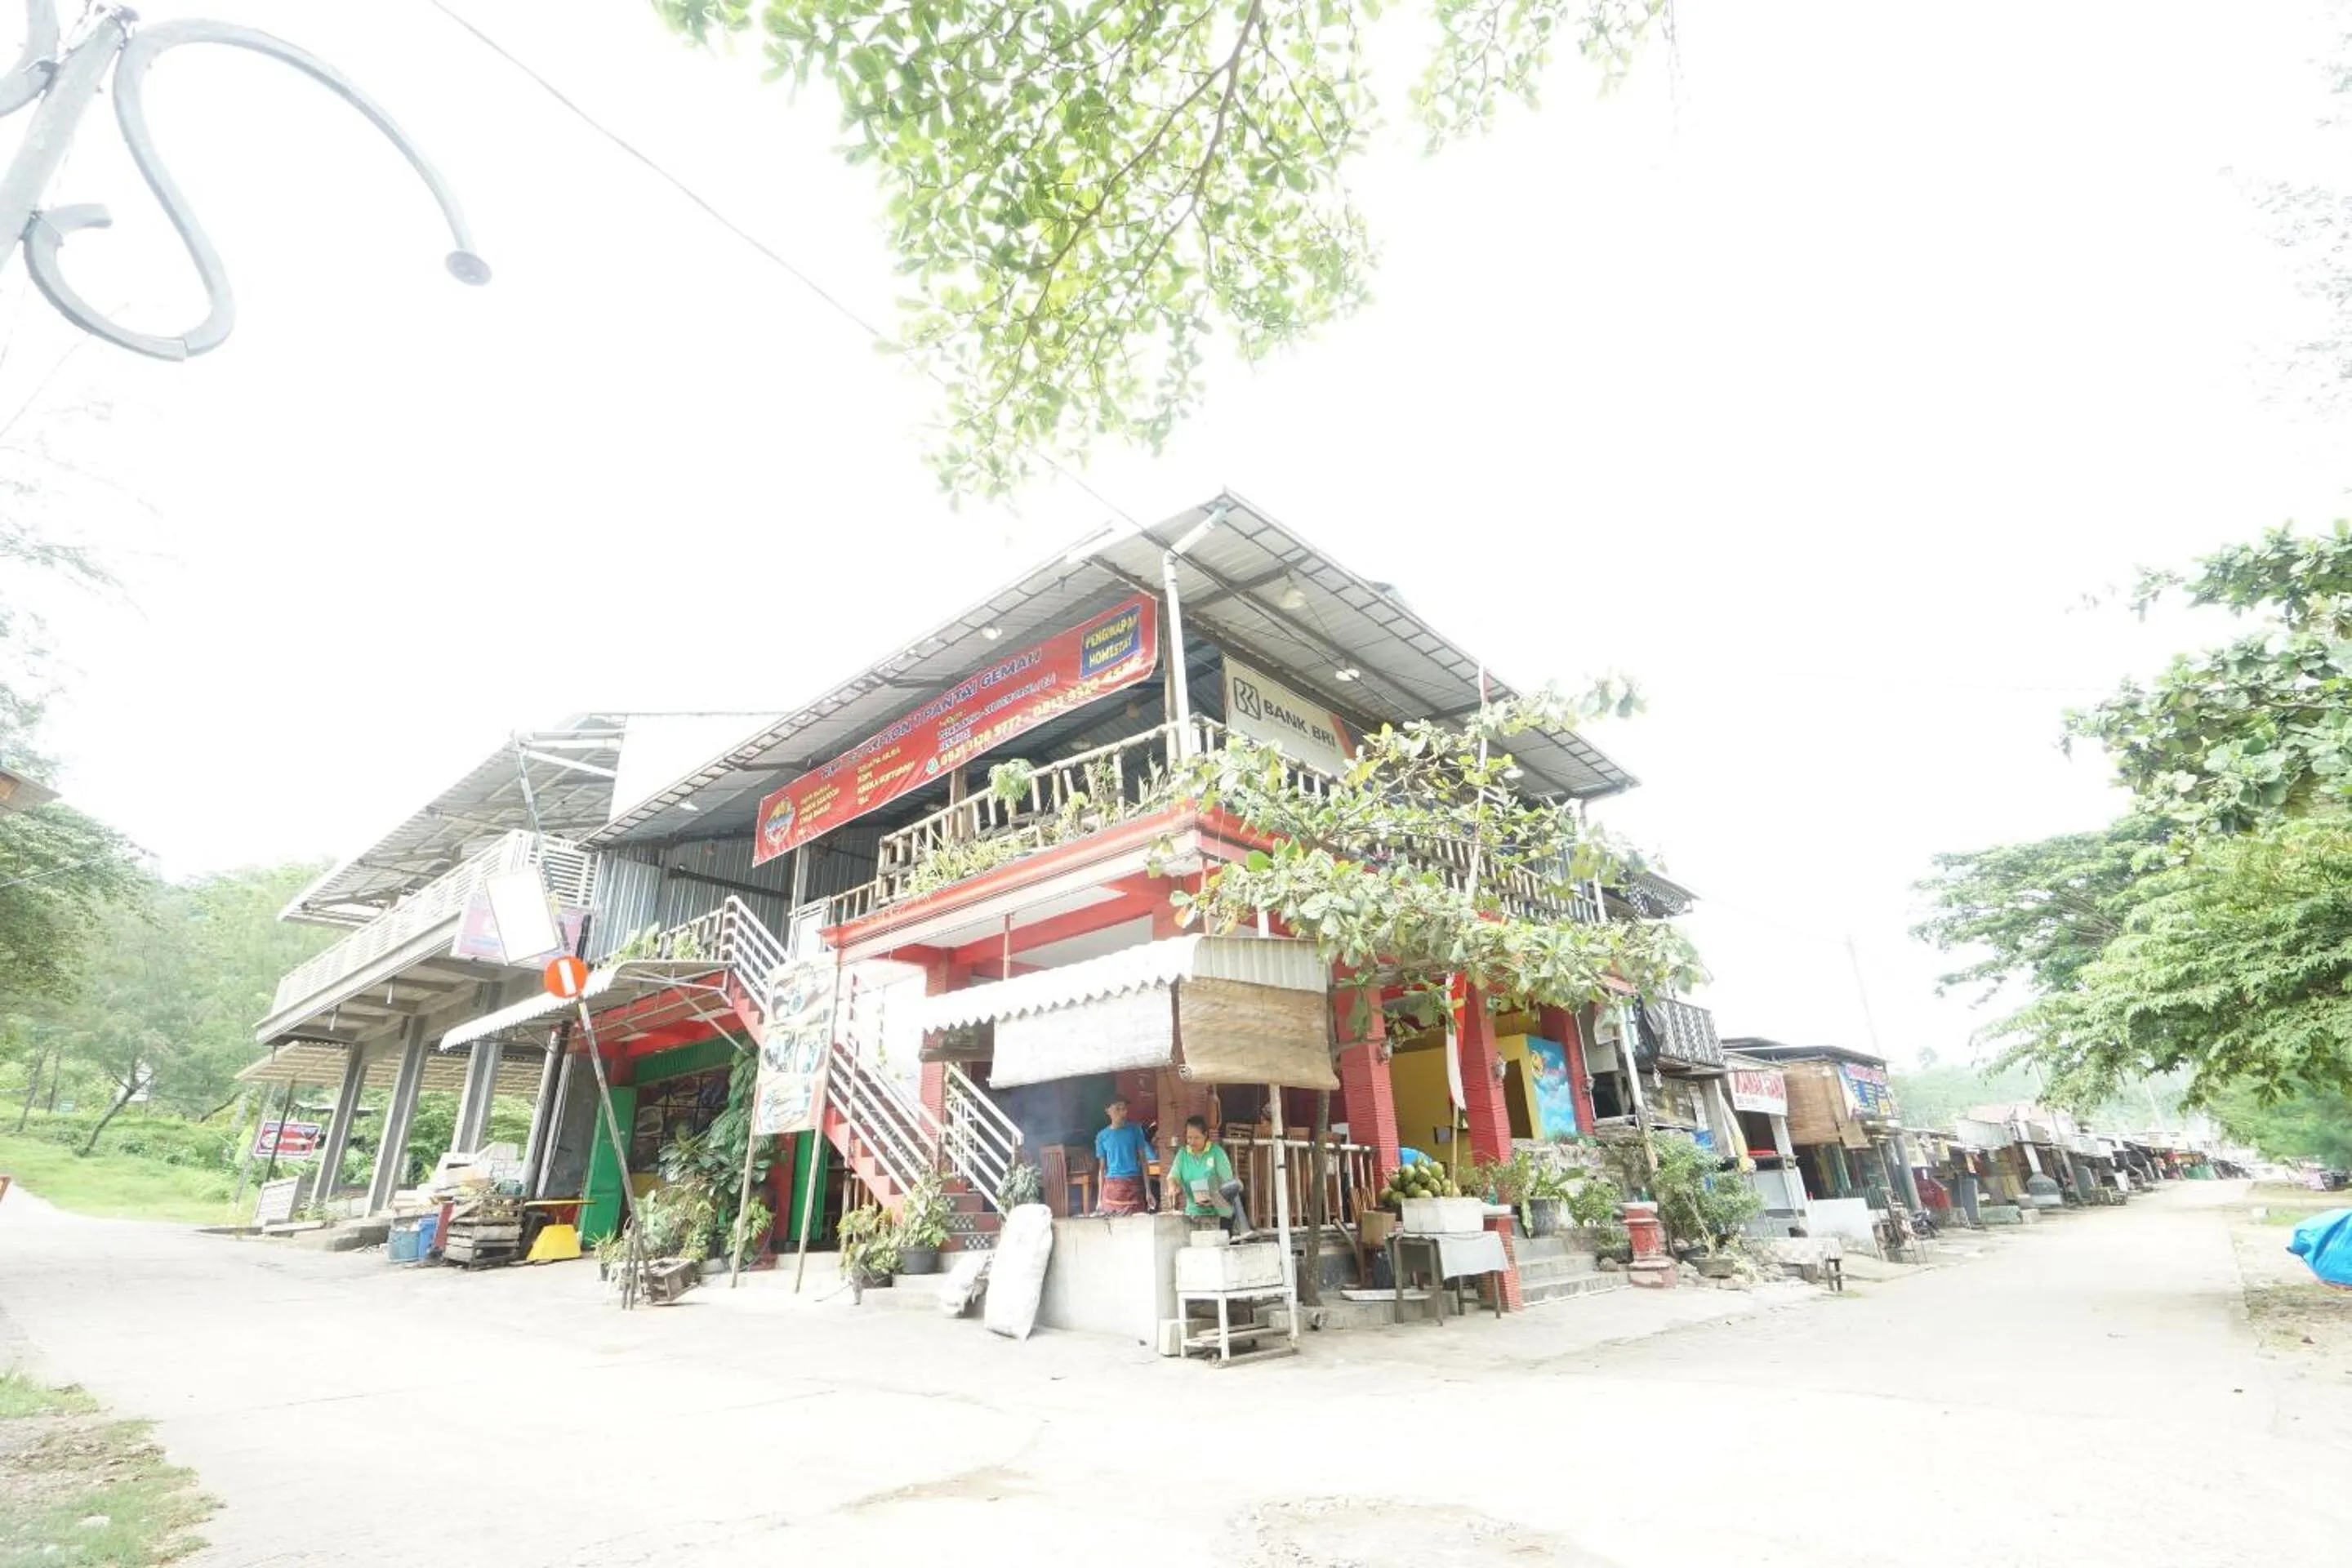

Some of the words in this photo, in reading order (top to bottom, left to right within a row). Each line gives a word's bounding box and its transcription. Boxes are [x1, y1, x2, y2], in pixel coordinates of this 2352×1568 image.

[980, 647, 1043, 688] GEMAH
[1089, 633, 1133, 668] HOMESTAY
[1263, 699, 1307, 733] BANK
[1312, 725, 1336, 748] BRI
